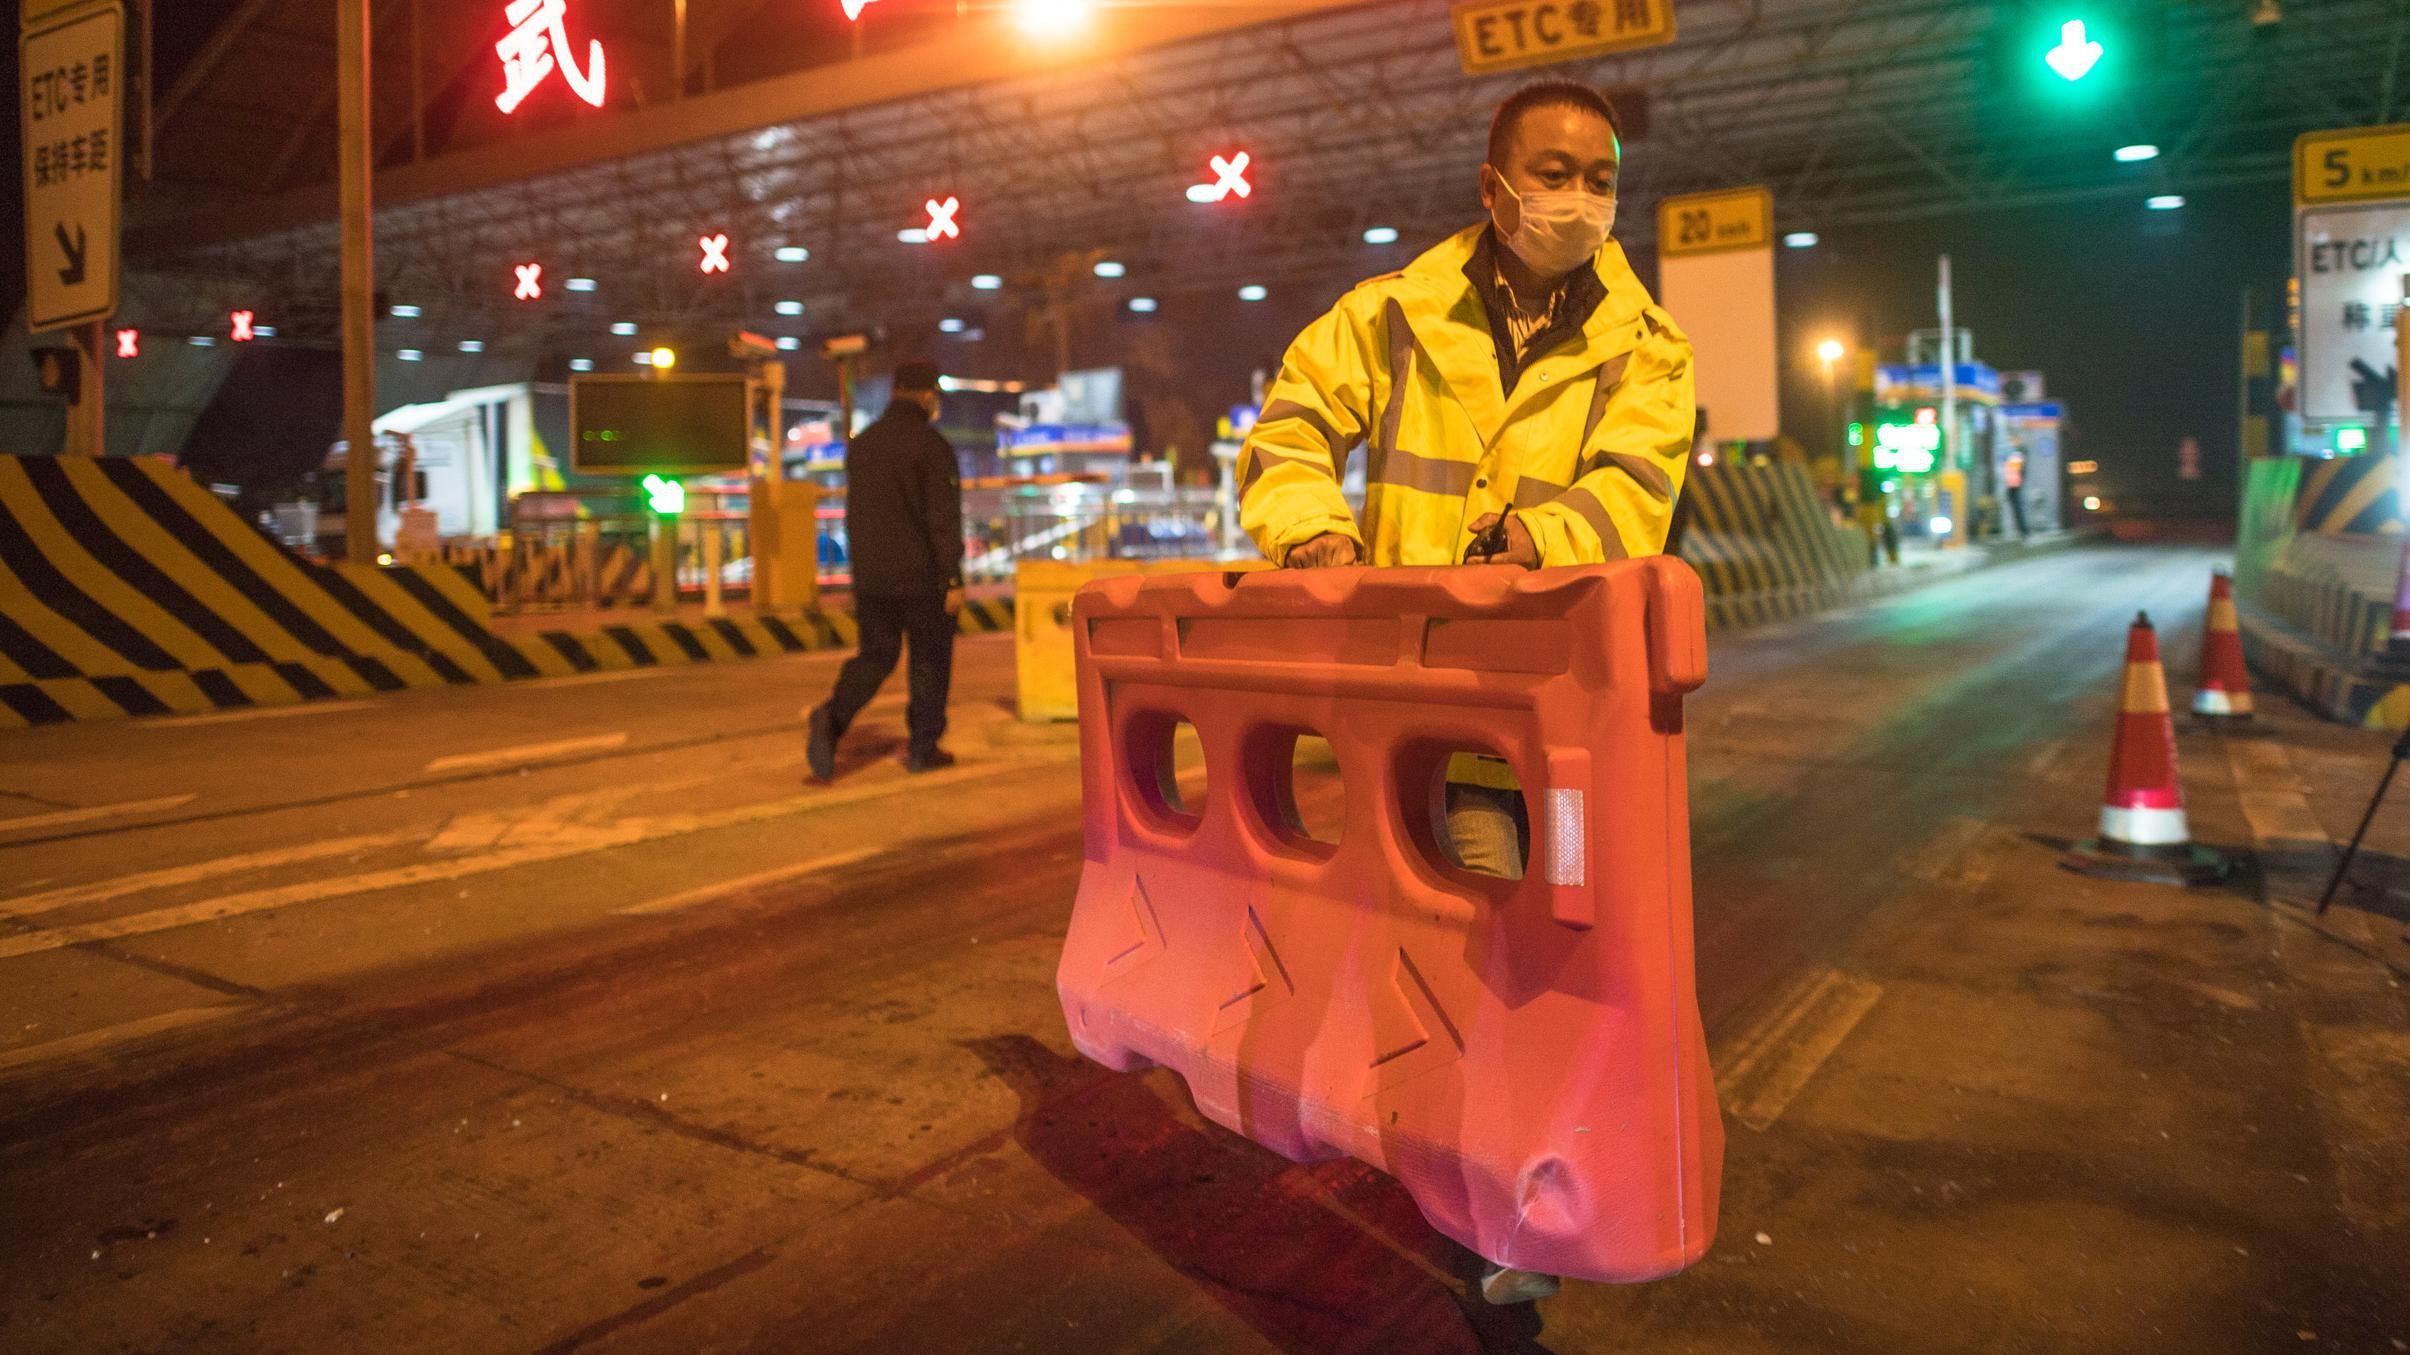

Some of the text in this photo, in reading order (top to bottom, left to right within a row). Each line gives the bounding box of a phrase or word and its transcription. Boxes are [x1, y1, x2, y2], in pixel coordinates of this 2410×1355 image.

[494, 0, 606, 114] 武
[1473, 0, 1651, 57] ETC专用
[31, 54, 109, 121] ETC专用
[2323, 150, 2351, 189] 5
[1679, 207, 1712, 244] 20
